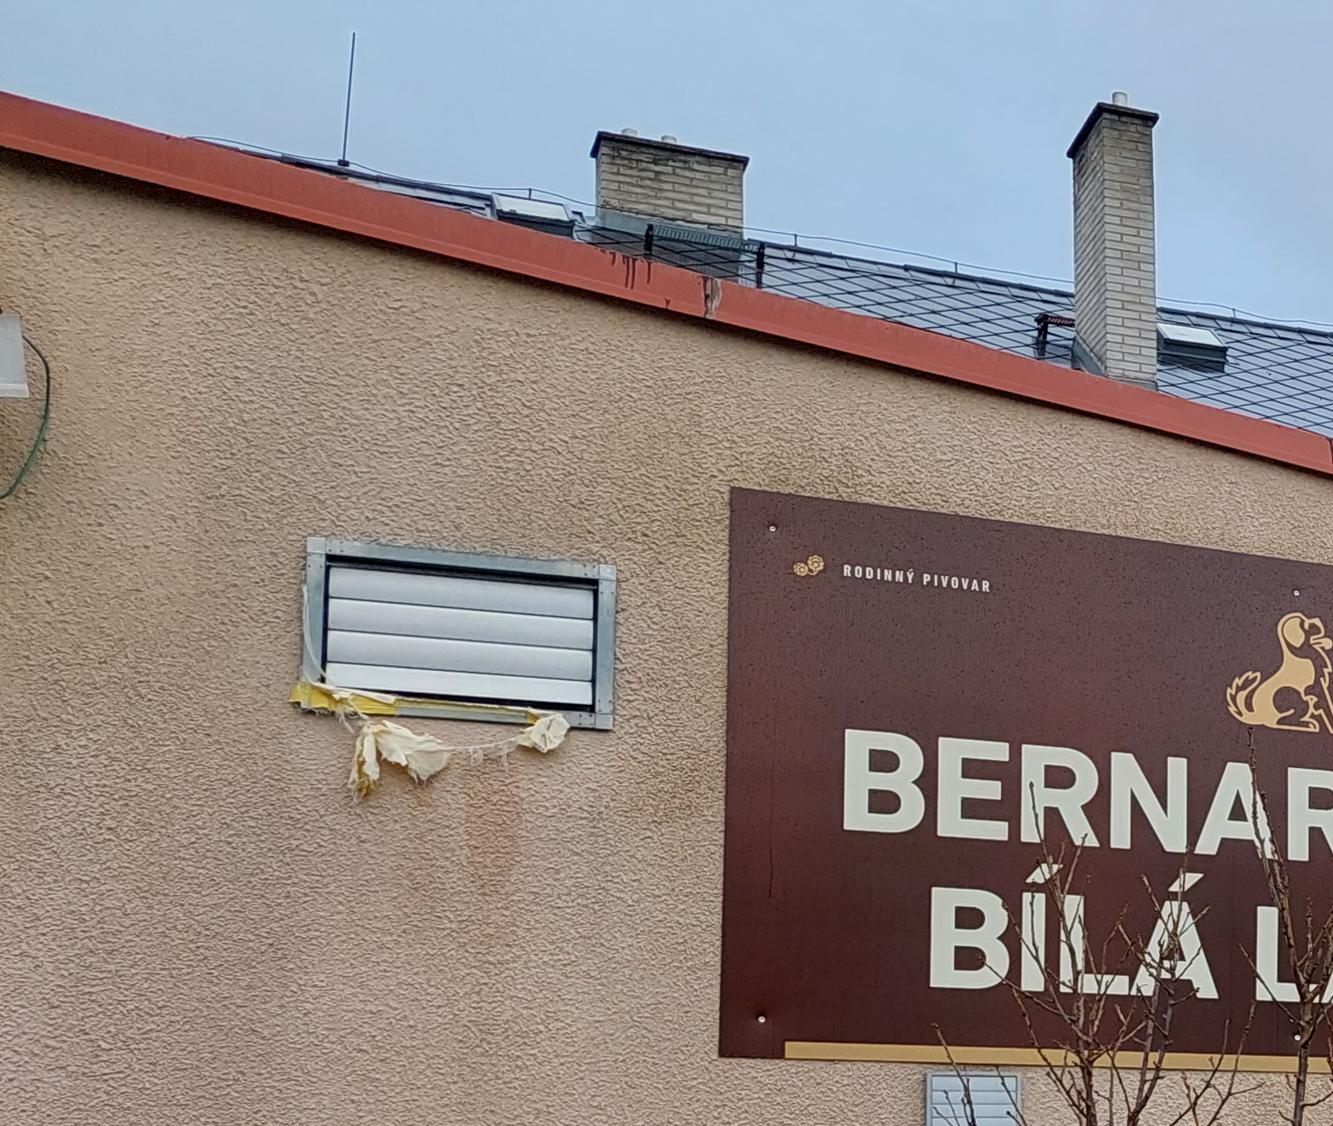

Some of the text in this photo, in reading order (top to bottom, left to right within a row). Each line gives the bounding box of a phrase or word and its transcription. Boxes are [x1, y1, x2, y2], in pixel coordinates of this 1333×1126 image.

[843, 564, 991, 593] RODINNÝ PIVOVAR
[929, 863, 1219, 1000] BÍLÁ
